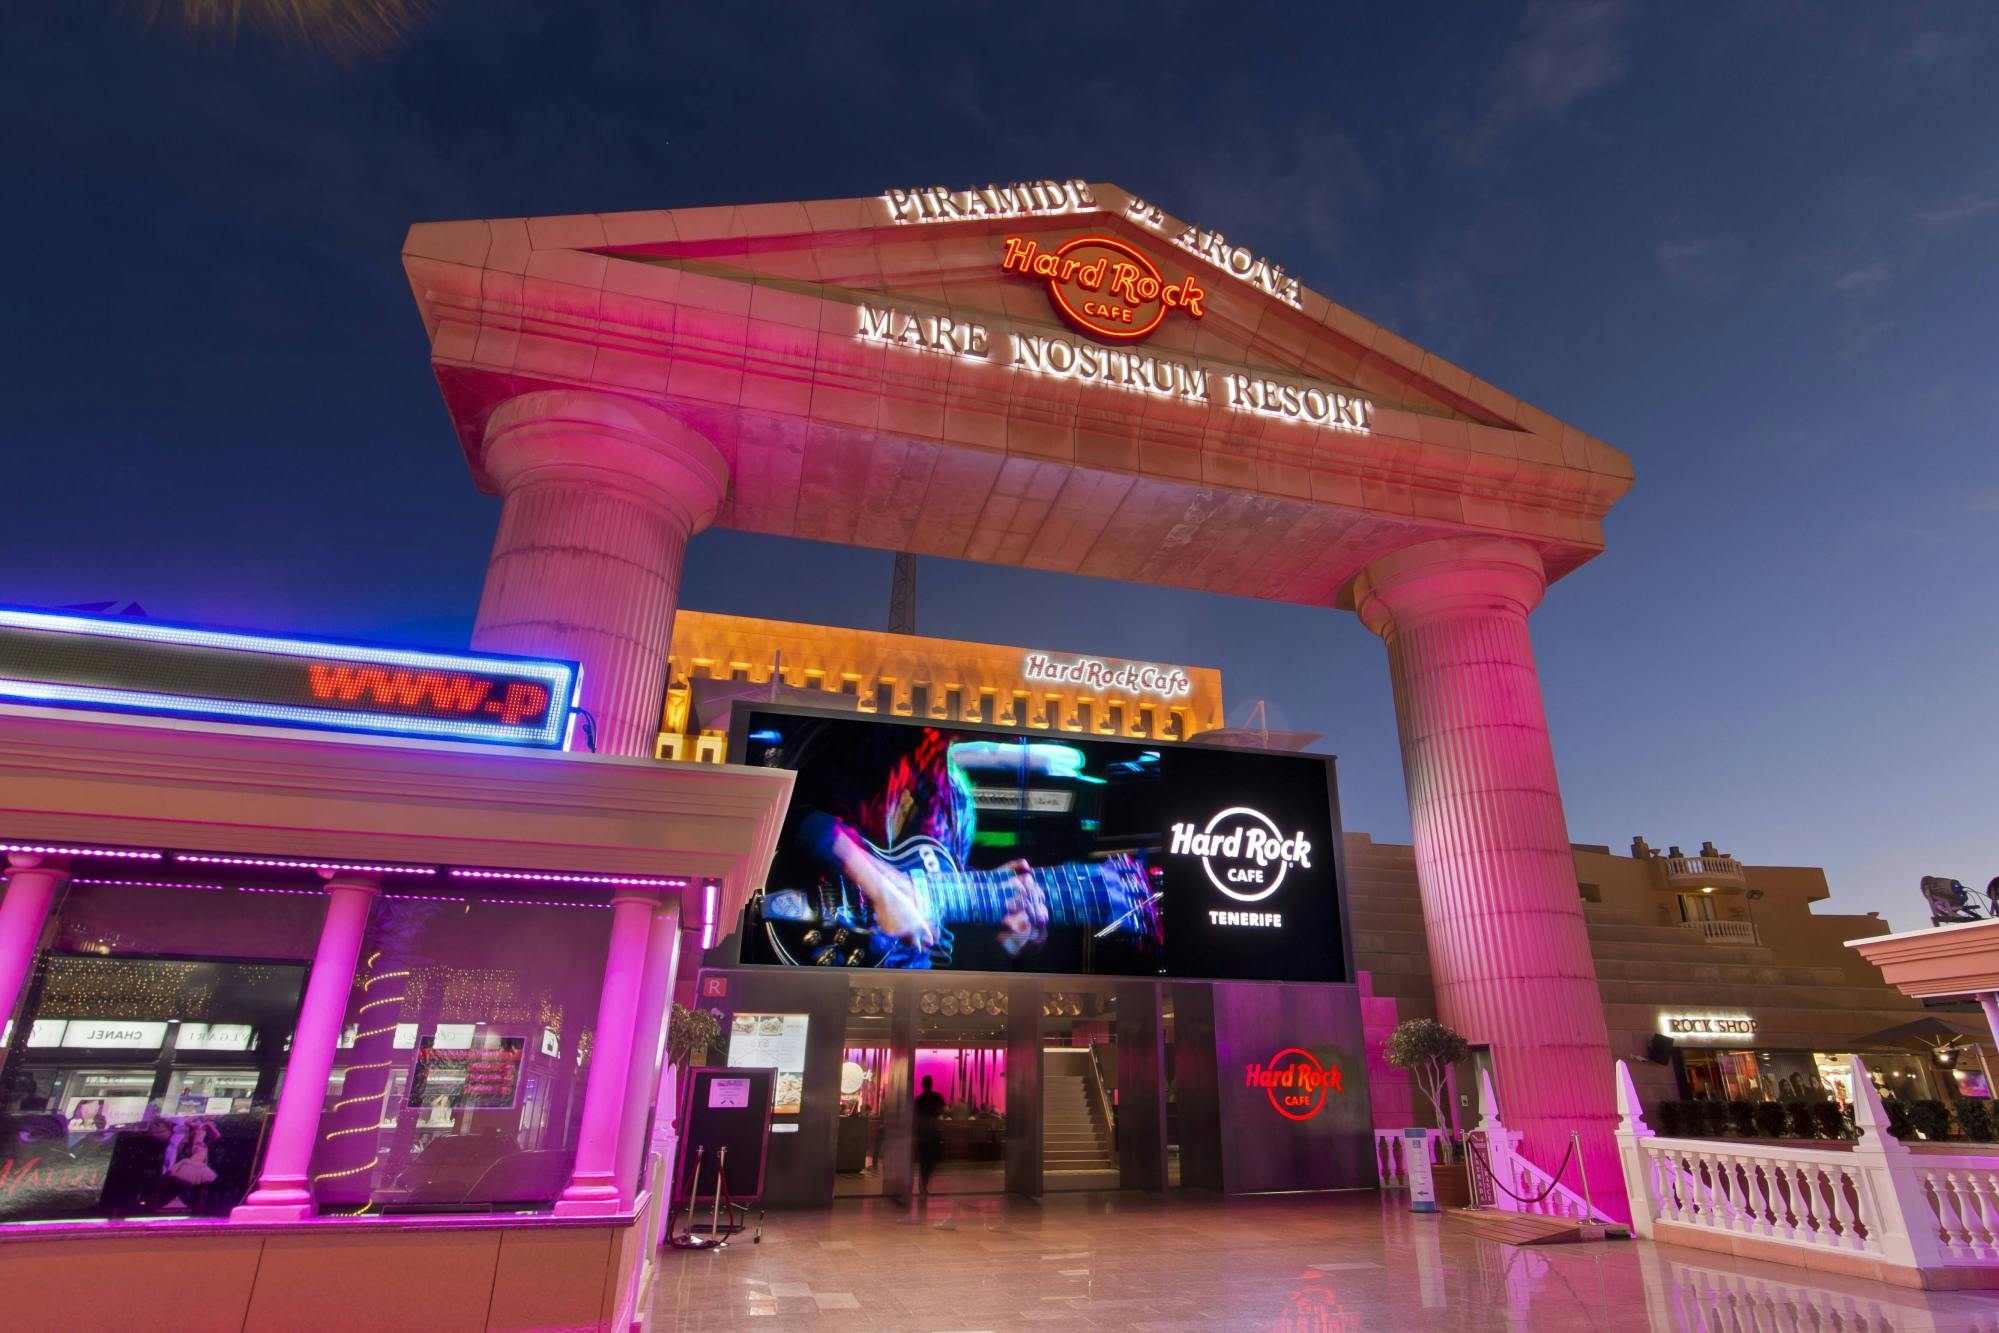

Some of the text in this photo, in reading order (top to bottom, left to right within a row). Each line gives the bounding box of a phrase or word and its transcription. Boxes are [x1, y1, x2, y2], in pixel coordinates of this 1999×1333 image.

[885, 179, 1303, 306] PIRAMIDE DE ARONA
[1002, 238, 1206, 319] Hard Rock
[1083, 302, 1134, 323] CAFE
[858, 306, 1373, 431] MARE NOSTRUM RESORT
[1027, 655, 1190, 697] Hard Rock Cafe
[1170, 822, 1312, 868] Hard Rock
[1227, 868, 1265, 883] CAFE
[1208, 910, 1283, 928] TENERIFE
[709, 979, 721, 995] R
[1669, 1018, 1760, 1034] ROCK SHOP
[1245, 1061, 1344, 1093] Hard Rock
[1284, 1096, 1313, 1107] CAFE
